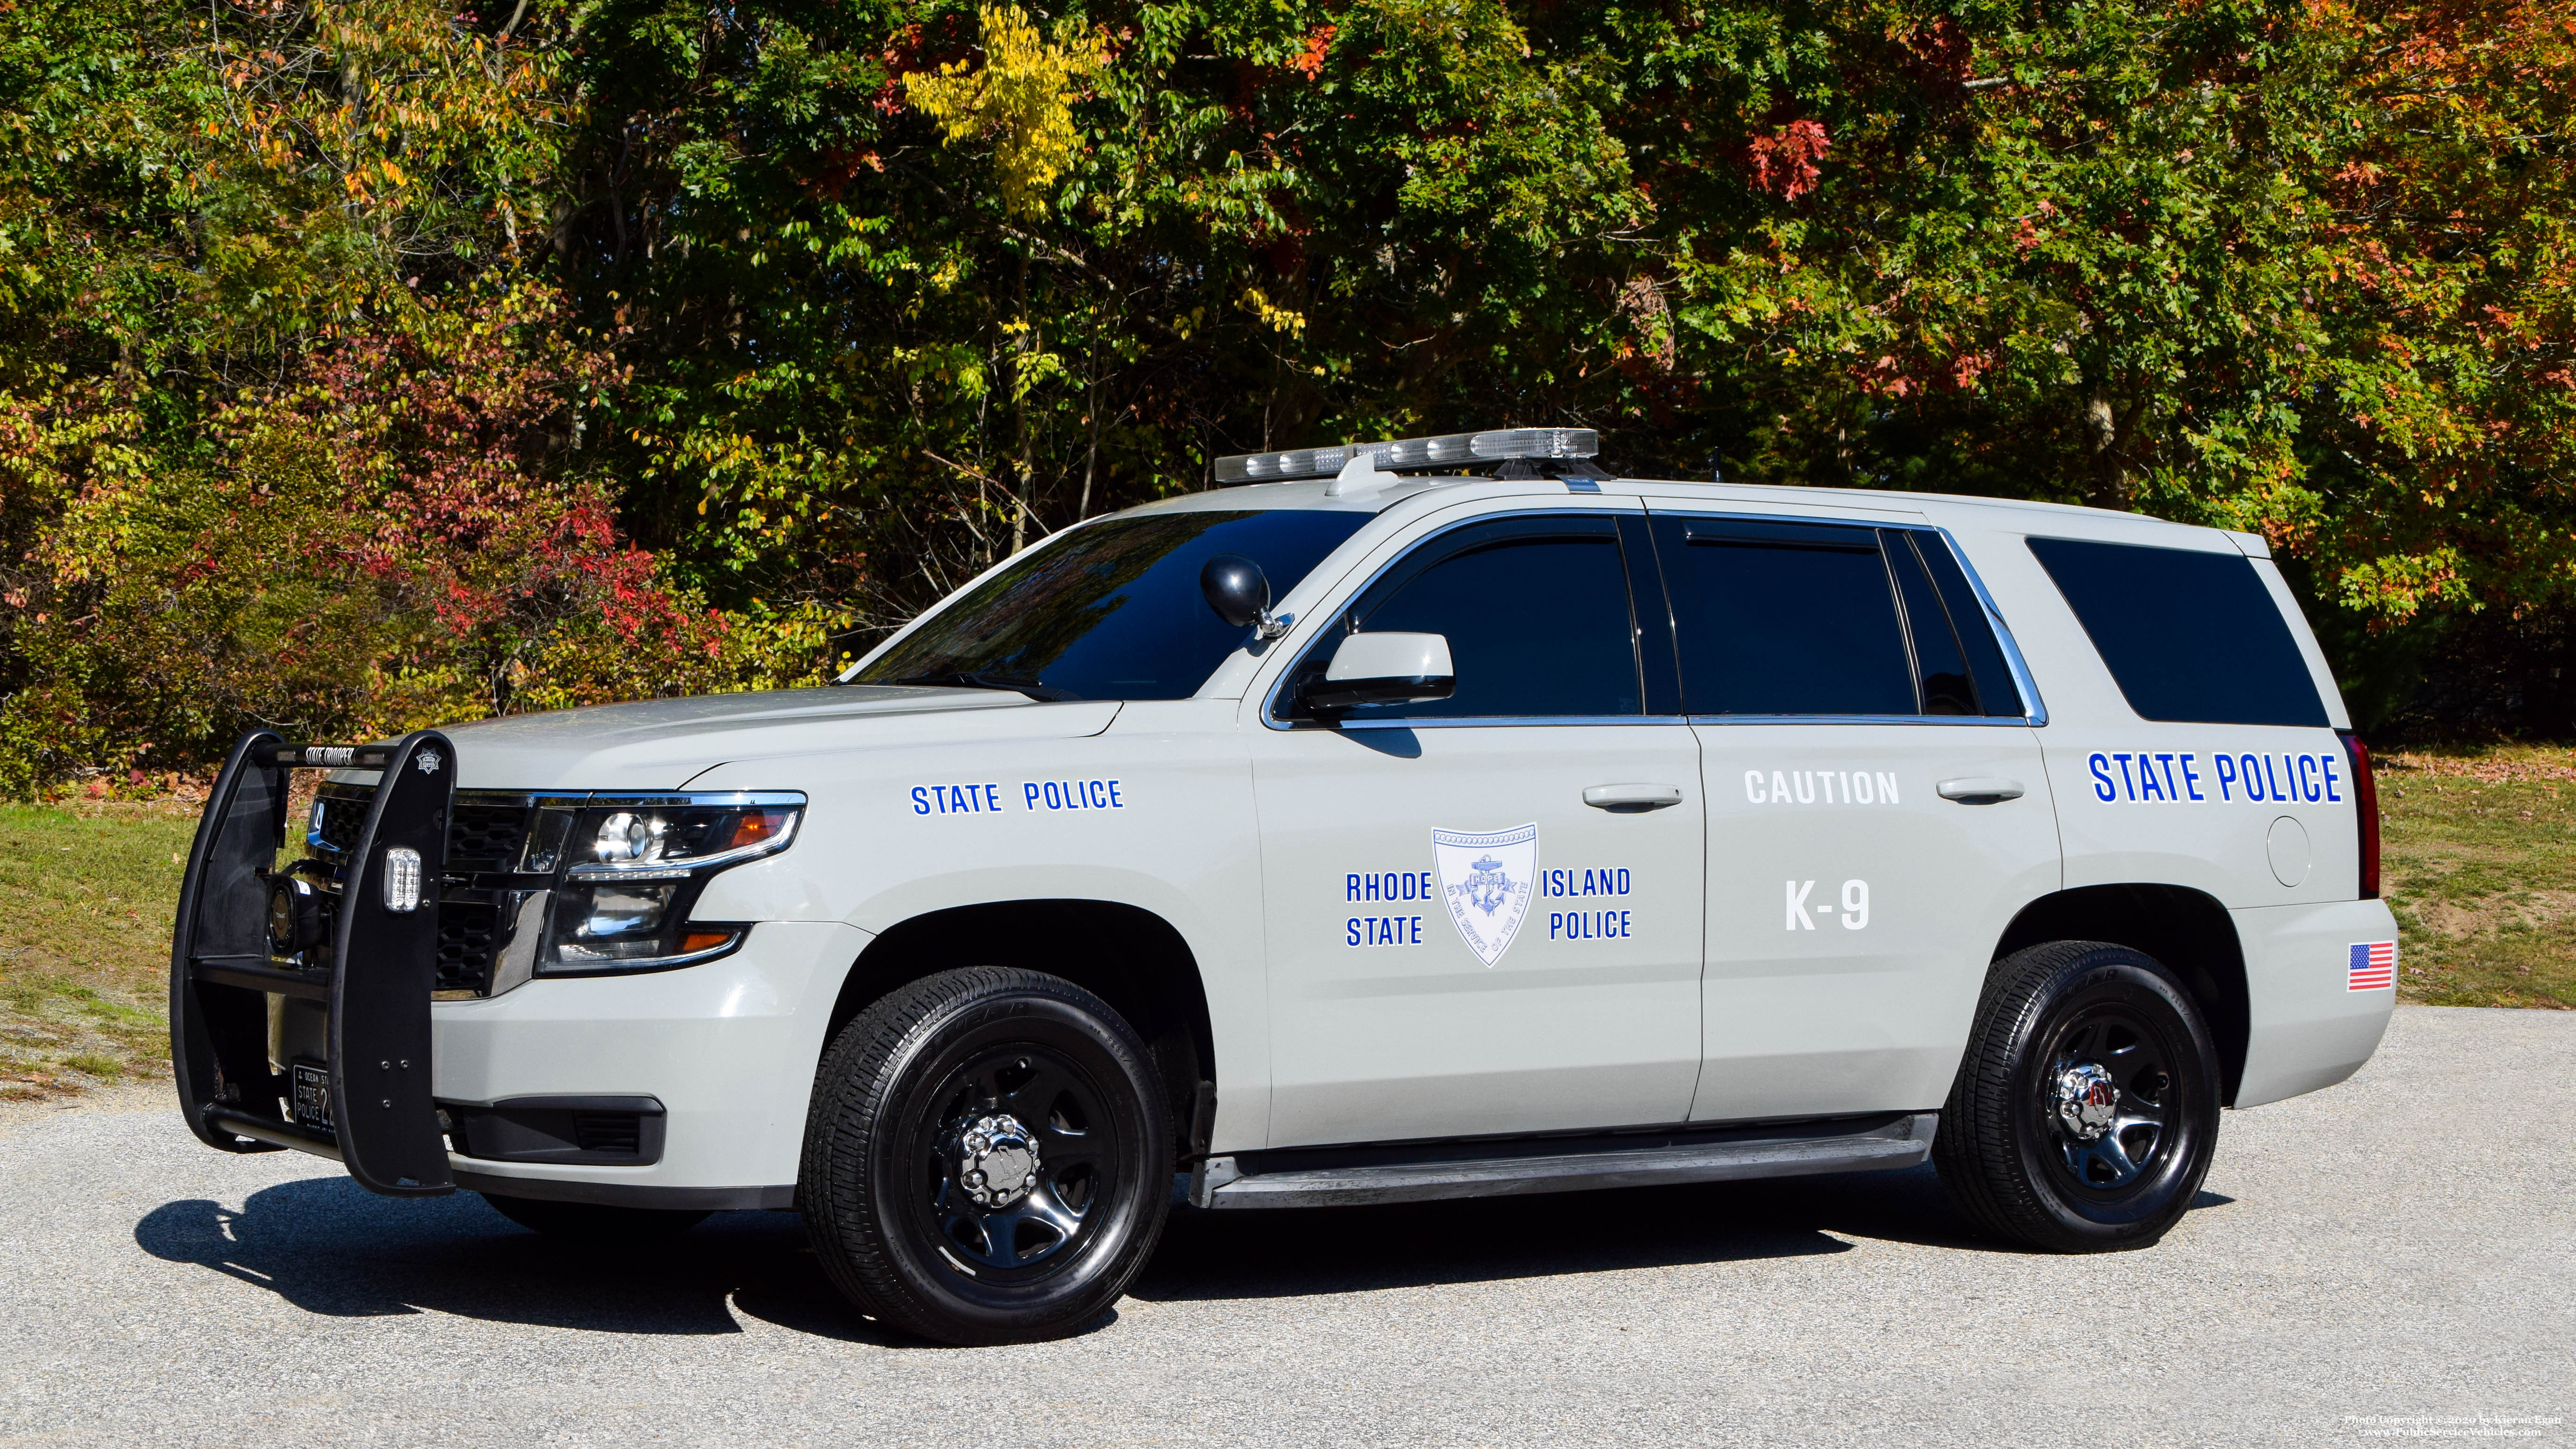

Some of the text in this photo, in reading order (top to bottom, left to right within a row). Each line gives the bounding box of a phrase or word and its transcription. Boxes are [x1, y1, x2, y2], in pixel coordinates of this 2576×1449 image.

[306, 747, 355, 765] STATE TROOPER
[1744, 770, 1900, 804] CAUTION
[2086, 751, 2343, 805] STATE POLICE
[910, 779, 1125, 816] STATE POLICE
[1346, 867, 1631, 903] RHODE ISLAND
[1447, 882, 1529, 953] IN THE SERVICE OF THE STATE
[1786, 879, 1869, 930] K-9
[1346, 909, 1631, 948] STATE POLICE
[298, 1085, 317, 1102] STATE
[305, 1072, 319, 1083] OCEAN
[297, 1102, 319, 1121] POLICE
